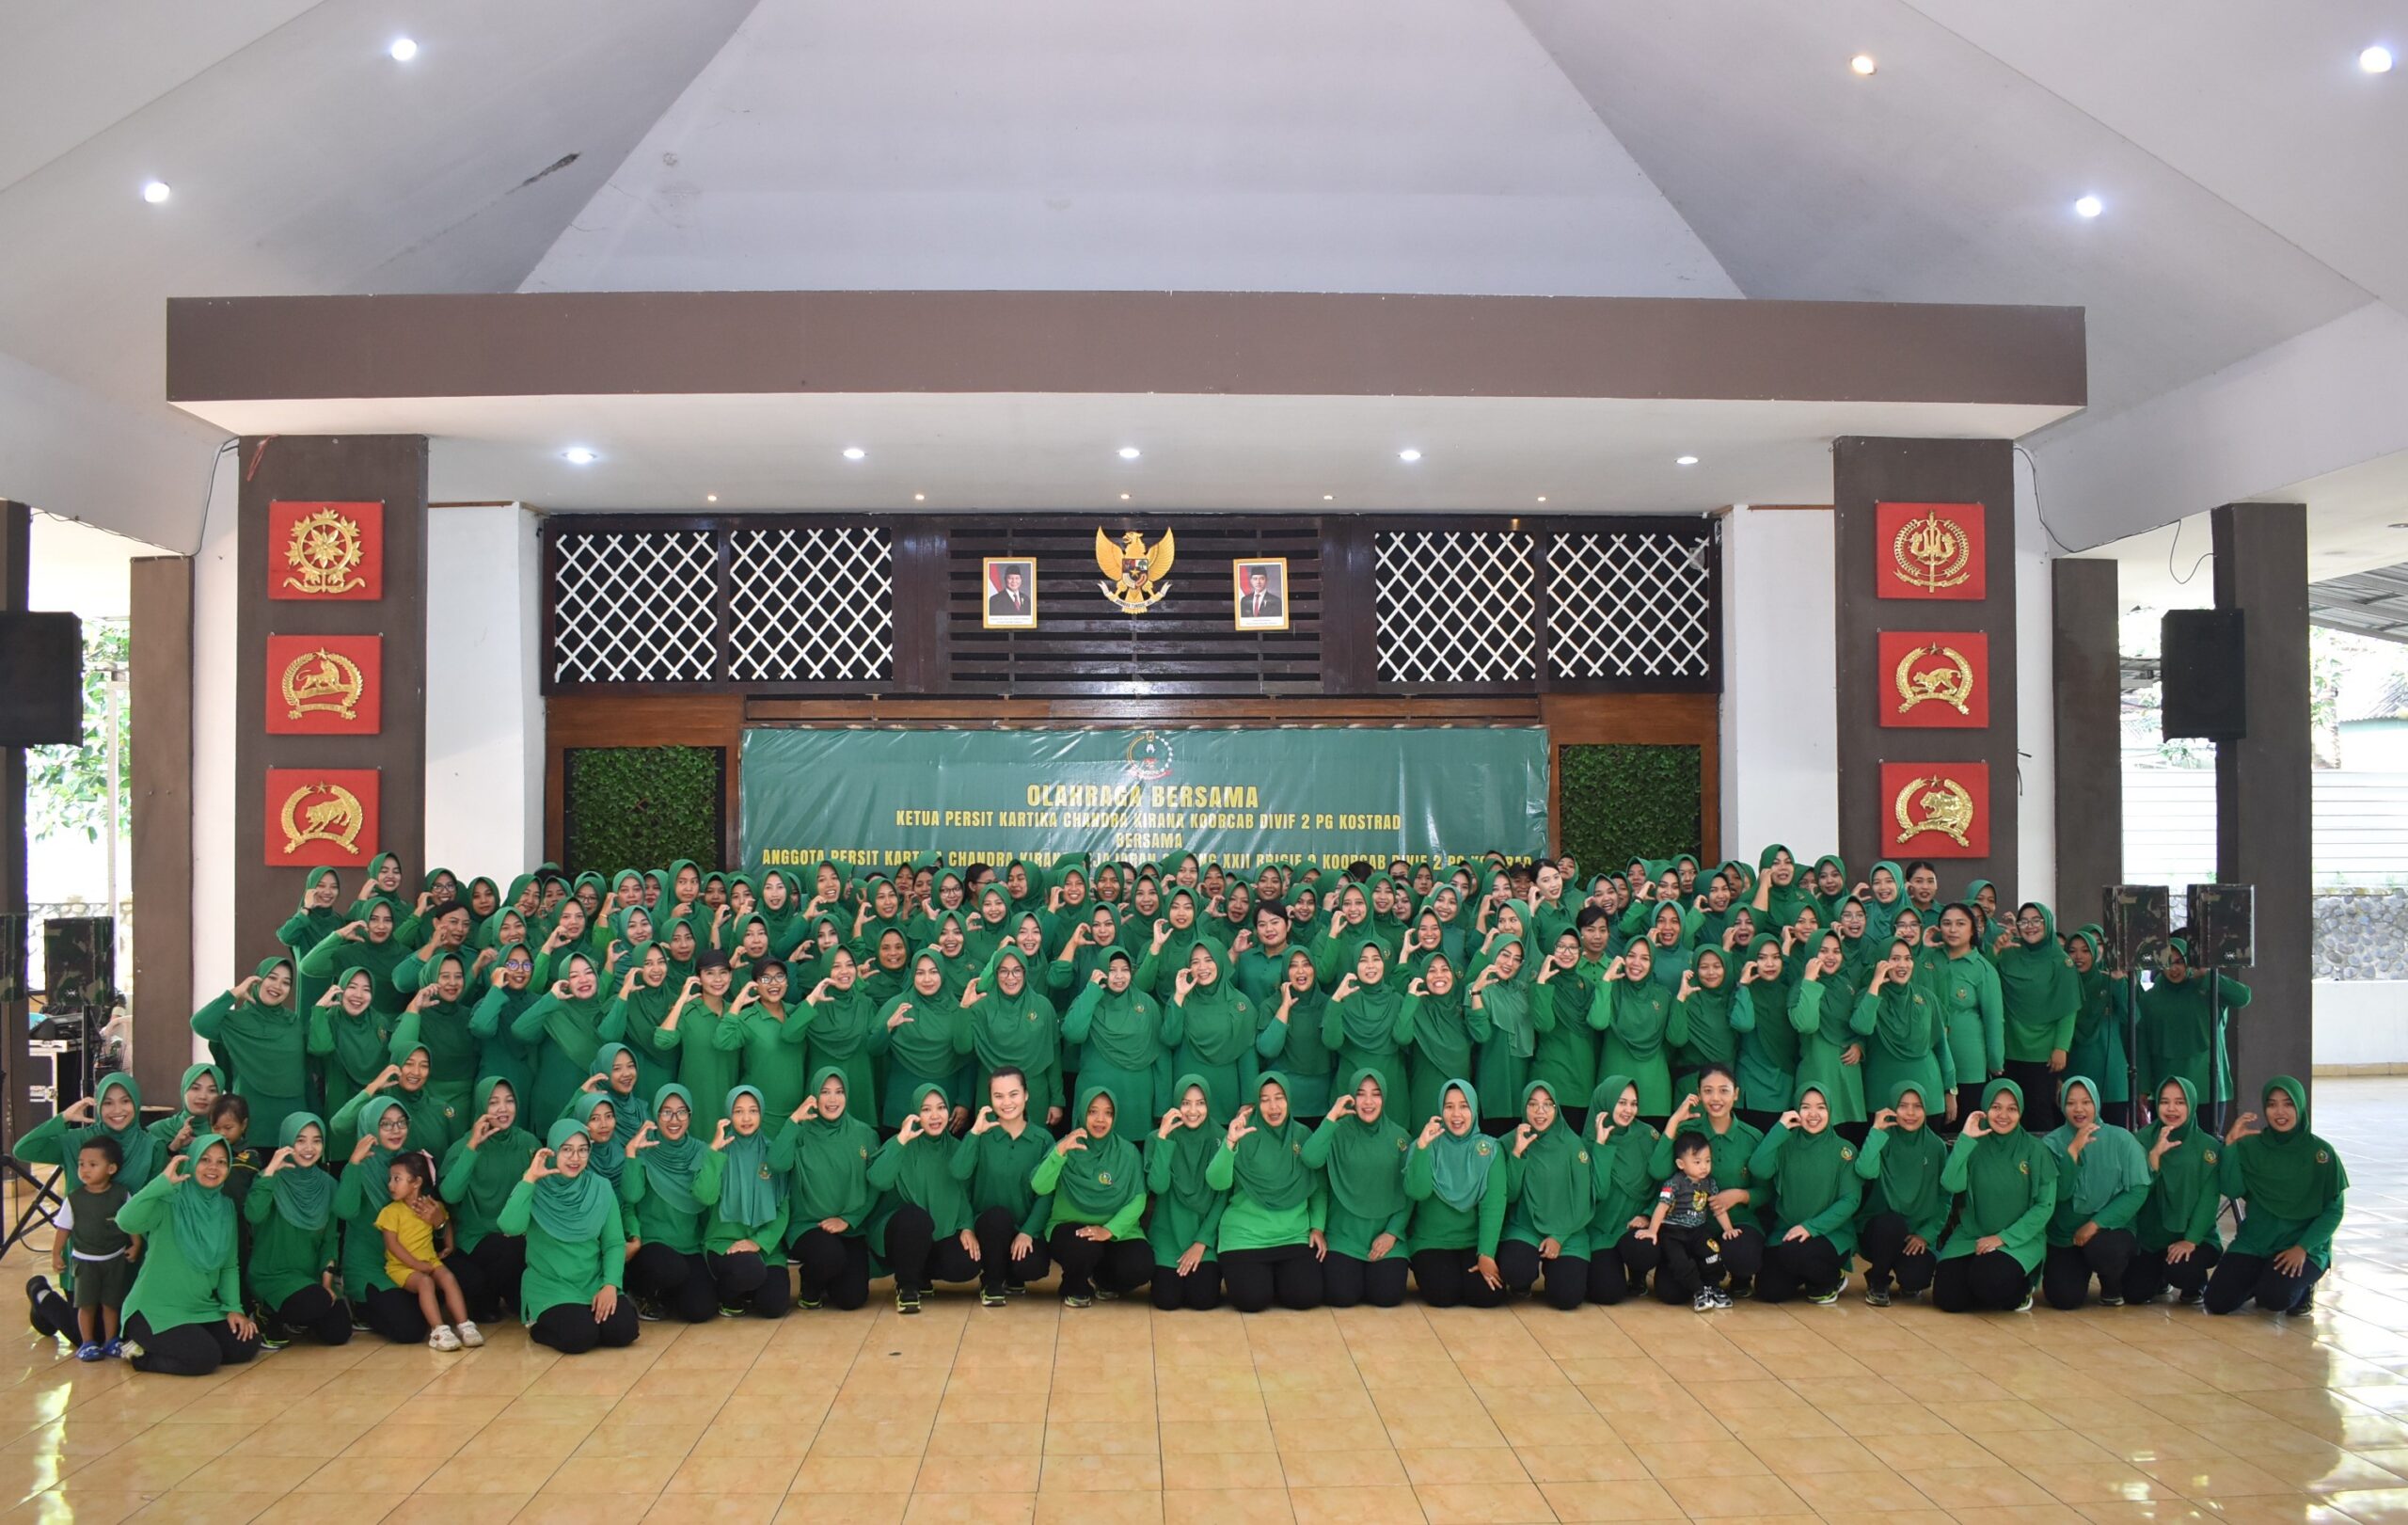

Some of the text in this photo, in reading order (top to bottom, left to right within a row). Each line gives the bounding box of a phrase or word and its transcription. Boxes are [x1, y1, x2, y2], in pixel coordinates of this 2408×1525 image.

[1027, 785, 1259, 808] OLAHRAGA BERSAMA
[896, 811, 1402, 830] KETUA PERSIT KARTIKA CHANDRA KIRANA KOORCAB DIVIF 2 PG KOSTRAD
[1116, 833, 1183, 849] BERSAMA
[763, 850, 824, 865] ANGGOTA
[948, 851, 1013, 866] CHANDRA
[1223, 853, 1250, 869] XXII
[1433, 854, 1442, 870] 2
